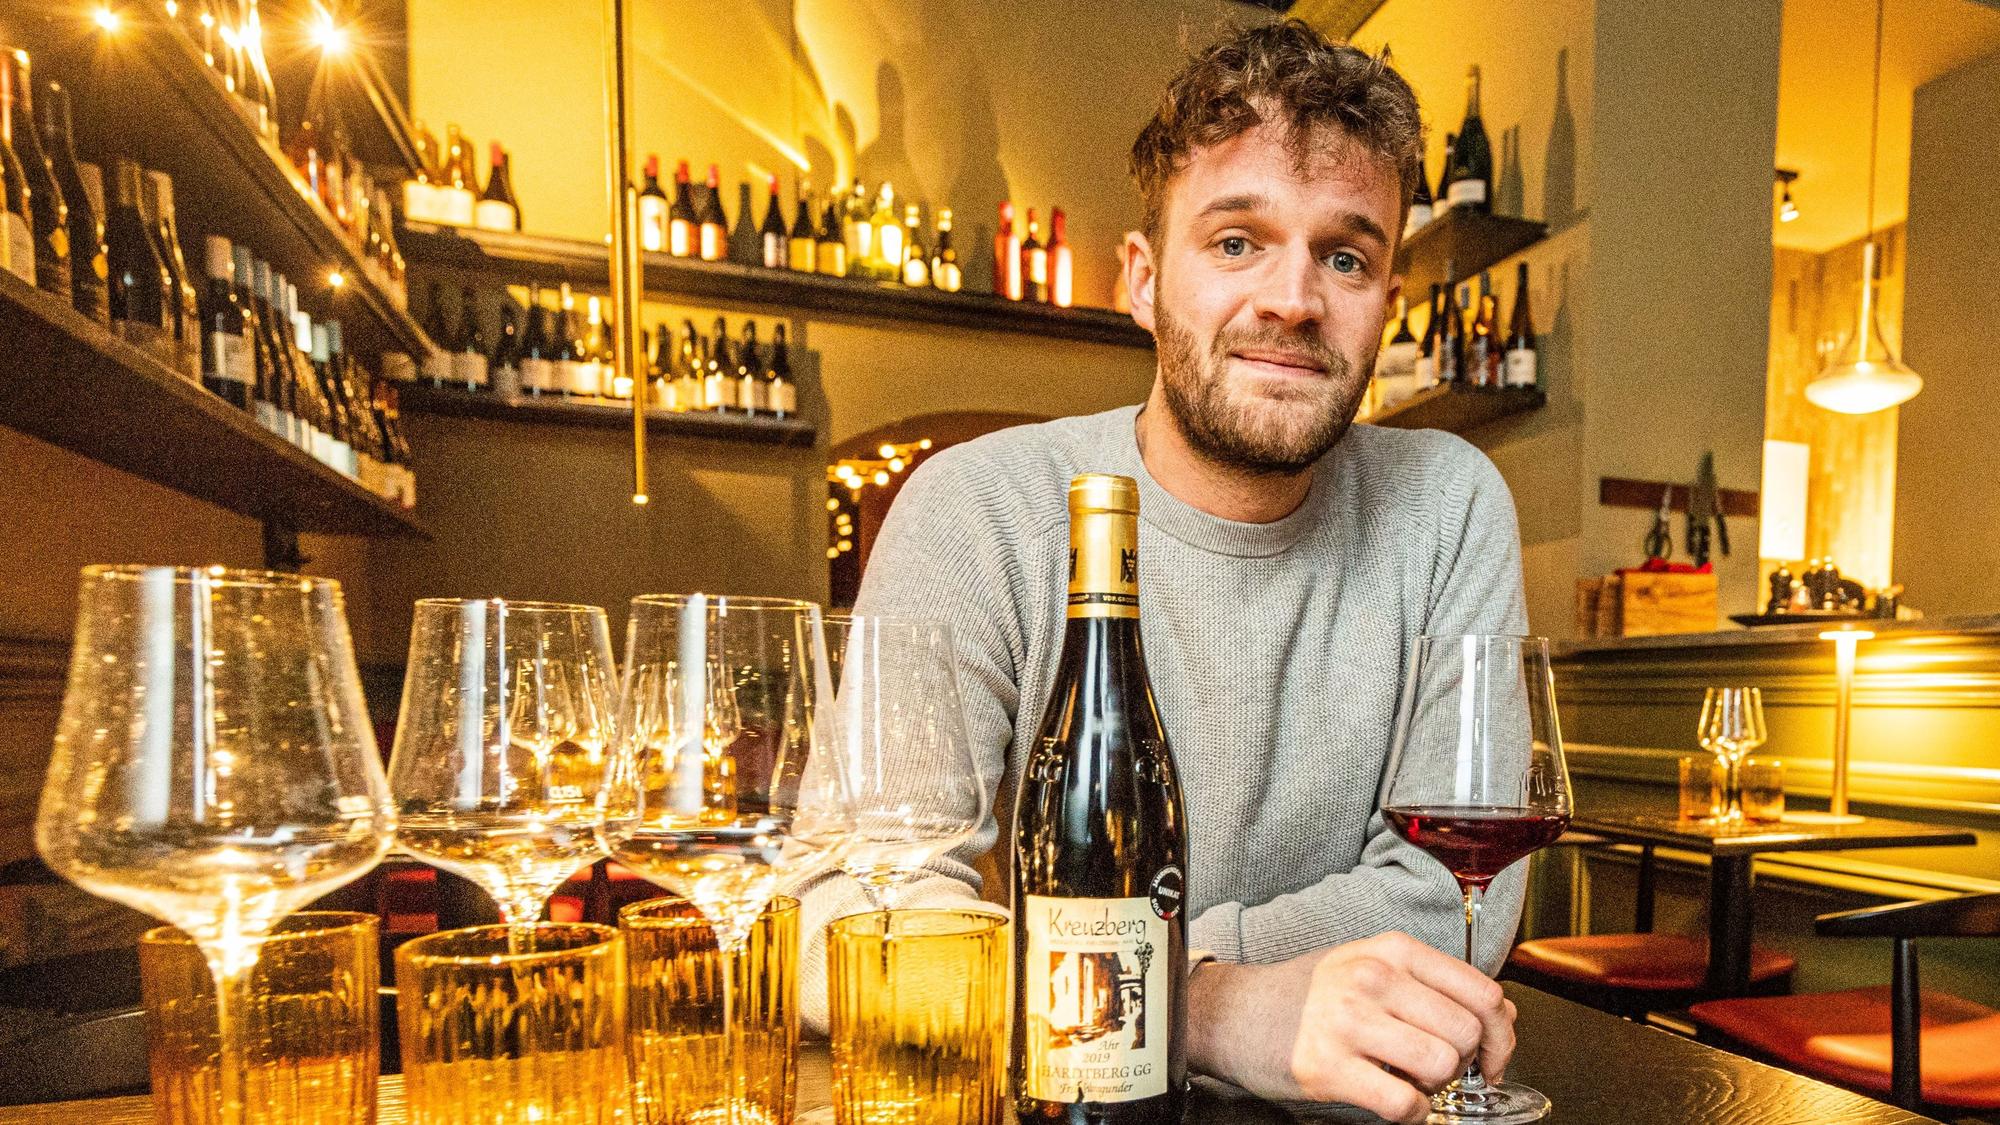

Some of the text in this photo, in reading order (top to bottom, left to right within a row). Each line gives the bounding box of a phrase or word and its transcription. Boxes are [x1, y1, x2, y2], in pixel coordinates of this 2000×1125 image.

[1049, 908, 1147, 944] Kreuzberg
[1098, 1040, 1120, 1051] Ahr
[1083, 1052, 1111, 1063] 2019
[1133, 1063, 1152, 1076] GG
